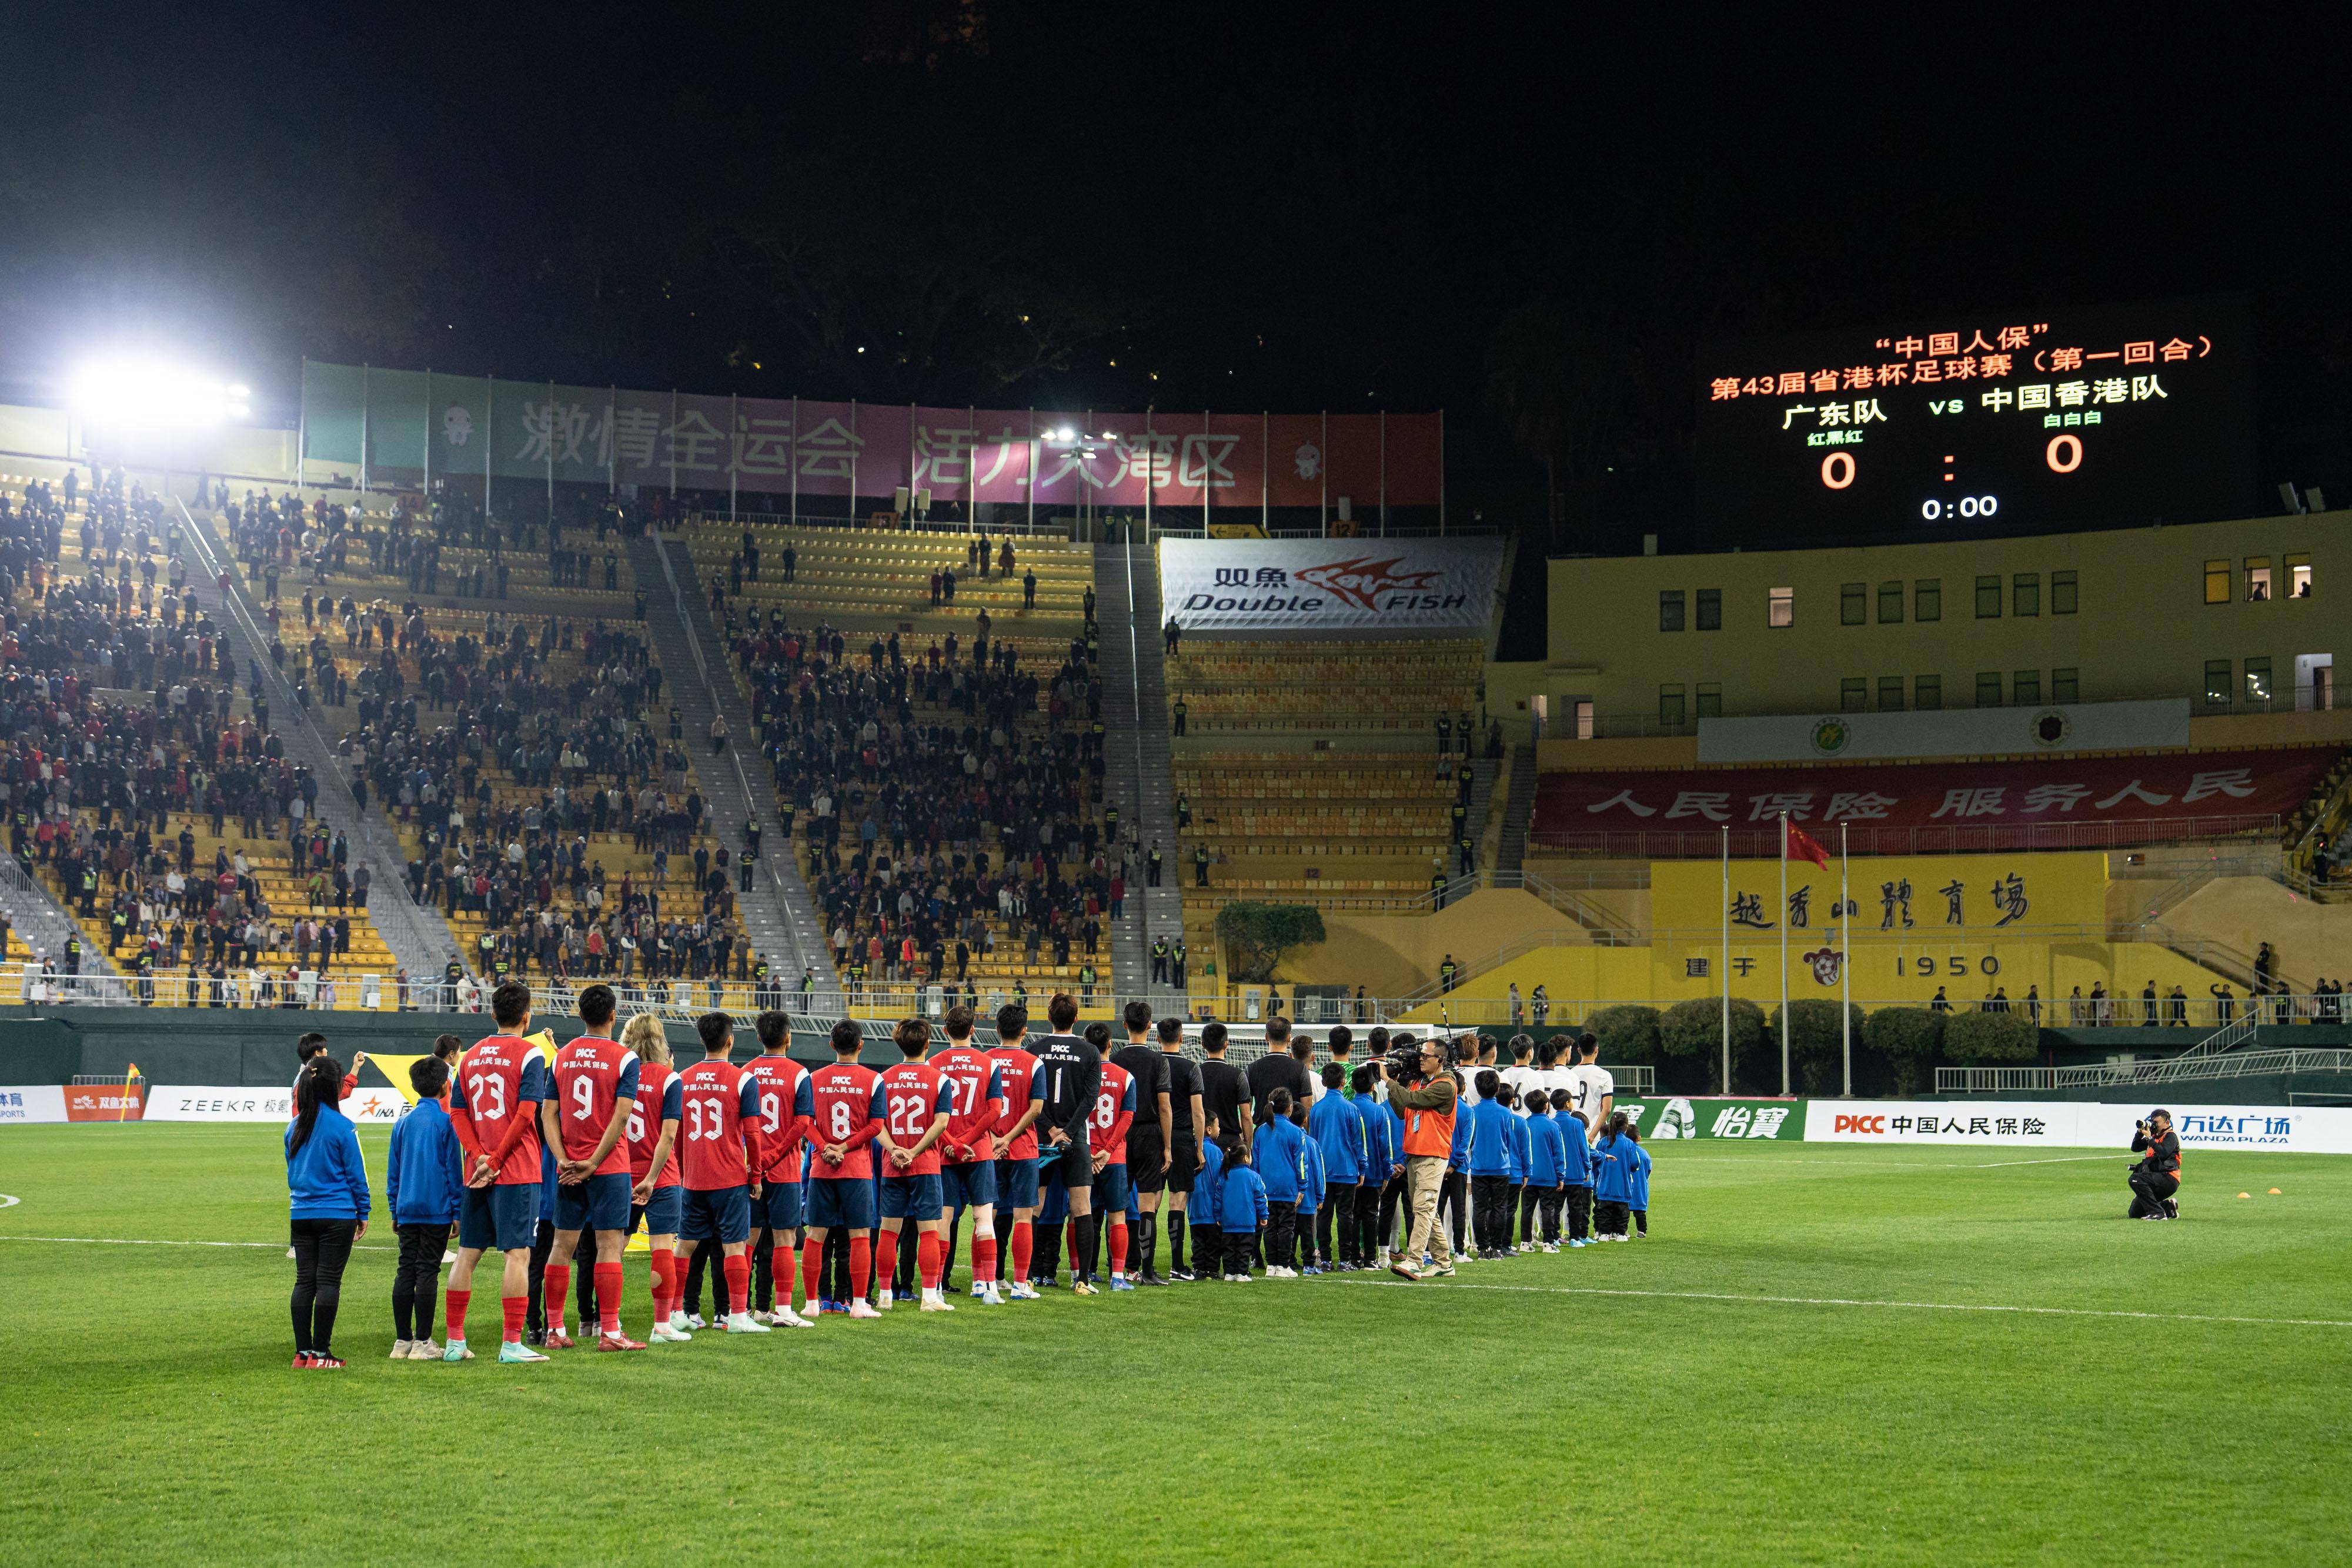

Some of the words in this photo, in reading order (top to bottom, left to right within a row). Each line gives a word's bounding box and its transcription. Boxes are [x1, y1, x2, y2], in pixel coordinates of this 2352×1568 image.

[1783, 398, 1887, 429] 广东队
[1982, 375, 2168, 413] 中国香港队
[1807, 430, 1863, 446] 红黑红
[2044, 410, 2102, 428] 白白白
[514, 402, 866, 479] 激情全运会
[914, 426, 1240, 489] 活力大湾区
[1822, 452, 1855, 489] 0
[2046, 434, 2083, 473] 0
[1922, 496, 1997, 520] 0:00
[1184, 593, 1323, 611] Double
[1385, 594, 1467, 610] FISH
[1587, 789, 1899, 821] 人民保险
[1929, 768, 2257, 818] 服务人民
[1896, 956, 2000, 977] 1950
[575, 1048, 596, 1058] PICC
[1038, 1054, 1081, 1062] 中国人民保险
[1051, 1045, 1070, 1053] PICC
[467, 1057, 511, 1068] 中国人民保险
[563, 1060, 609, 1070] 中国人民保险
[940, 1064, 983, 1072] 中国人民保险
[696, 1072, 716, 1082] PICC
[831, 1076, 851, 1085] PICC
[898, 1072, 918, 1080] PICC
[1054, 1067, 1062, 1104] 1
[469, 1072, 506, 1121] 23
[573, 1074, 593, 1121] 9
[683, 1084, 729, 1092] 中国人民保险
[818, 1086, 864, 1095] 中国人民保险
[180, 1100, 255, 1112] ZEEKR
[890, 1095, 926, 1135] 22
[1090, 1093, 1114, 1129] 8
[686, 1098, 723, 1142] 33
[831, 1101, 851, 1141] 8
[1710, 1106, 1789, 1139] 怡寶
[1835, 1115, 1885, 1134] PICC
[1892, 1115, 2046, 1135] 中国人民保险
[2180, 1115, 2290, 1135] 万达广场
